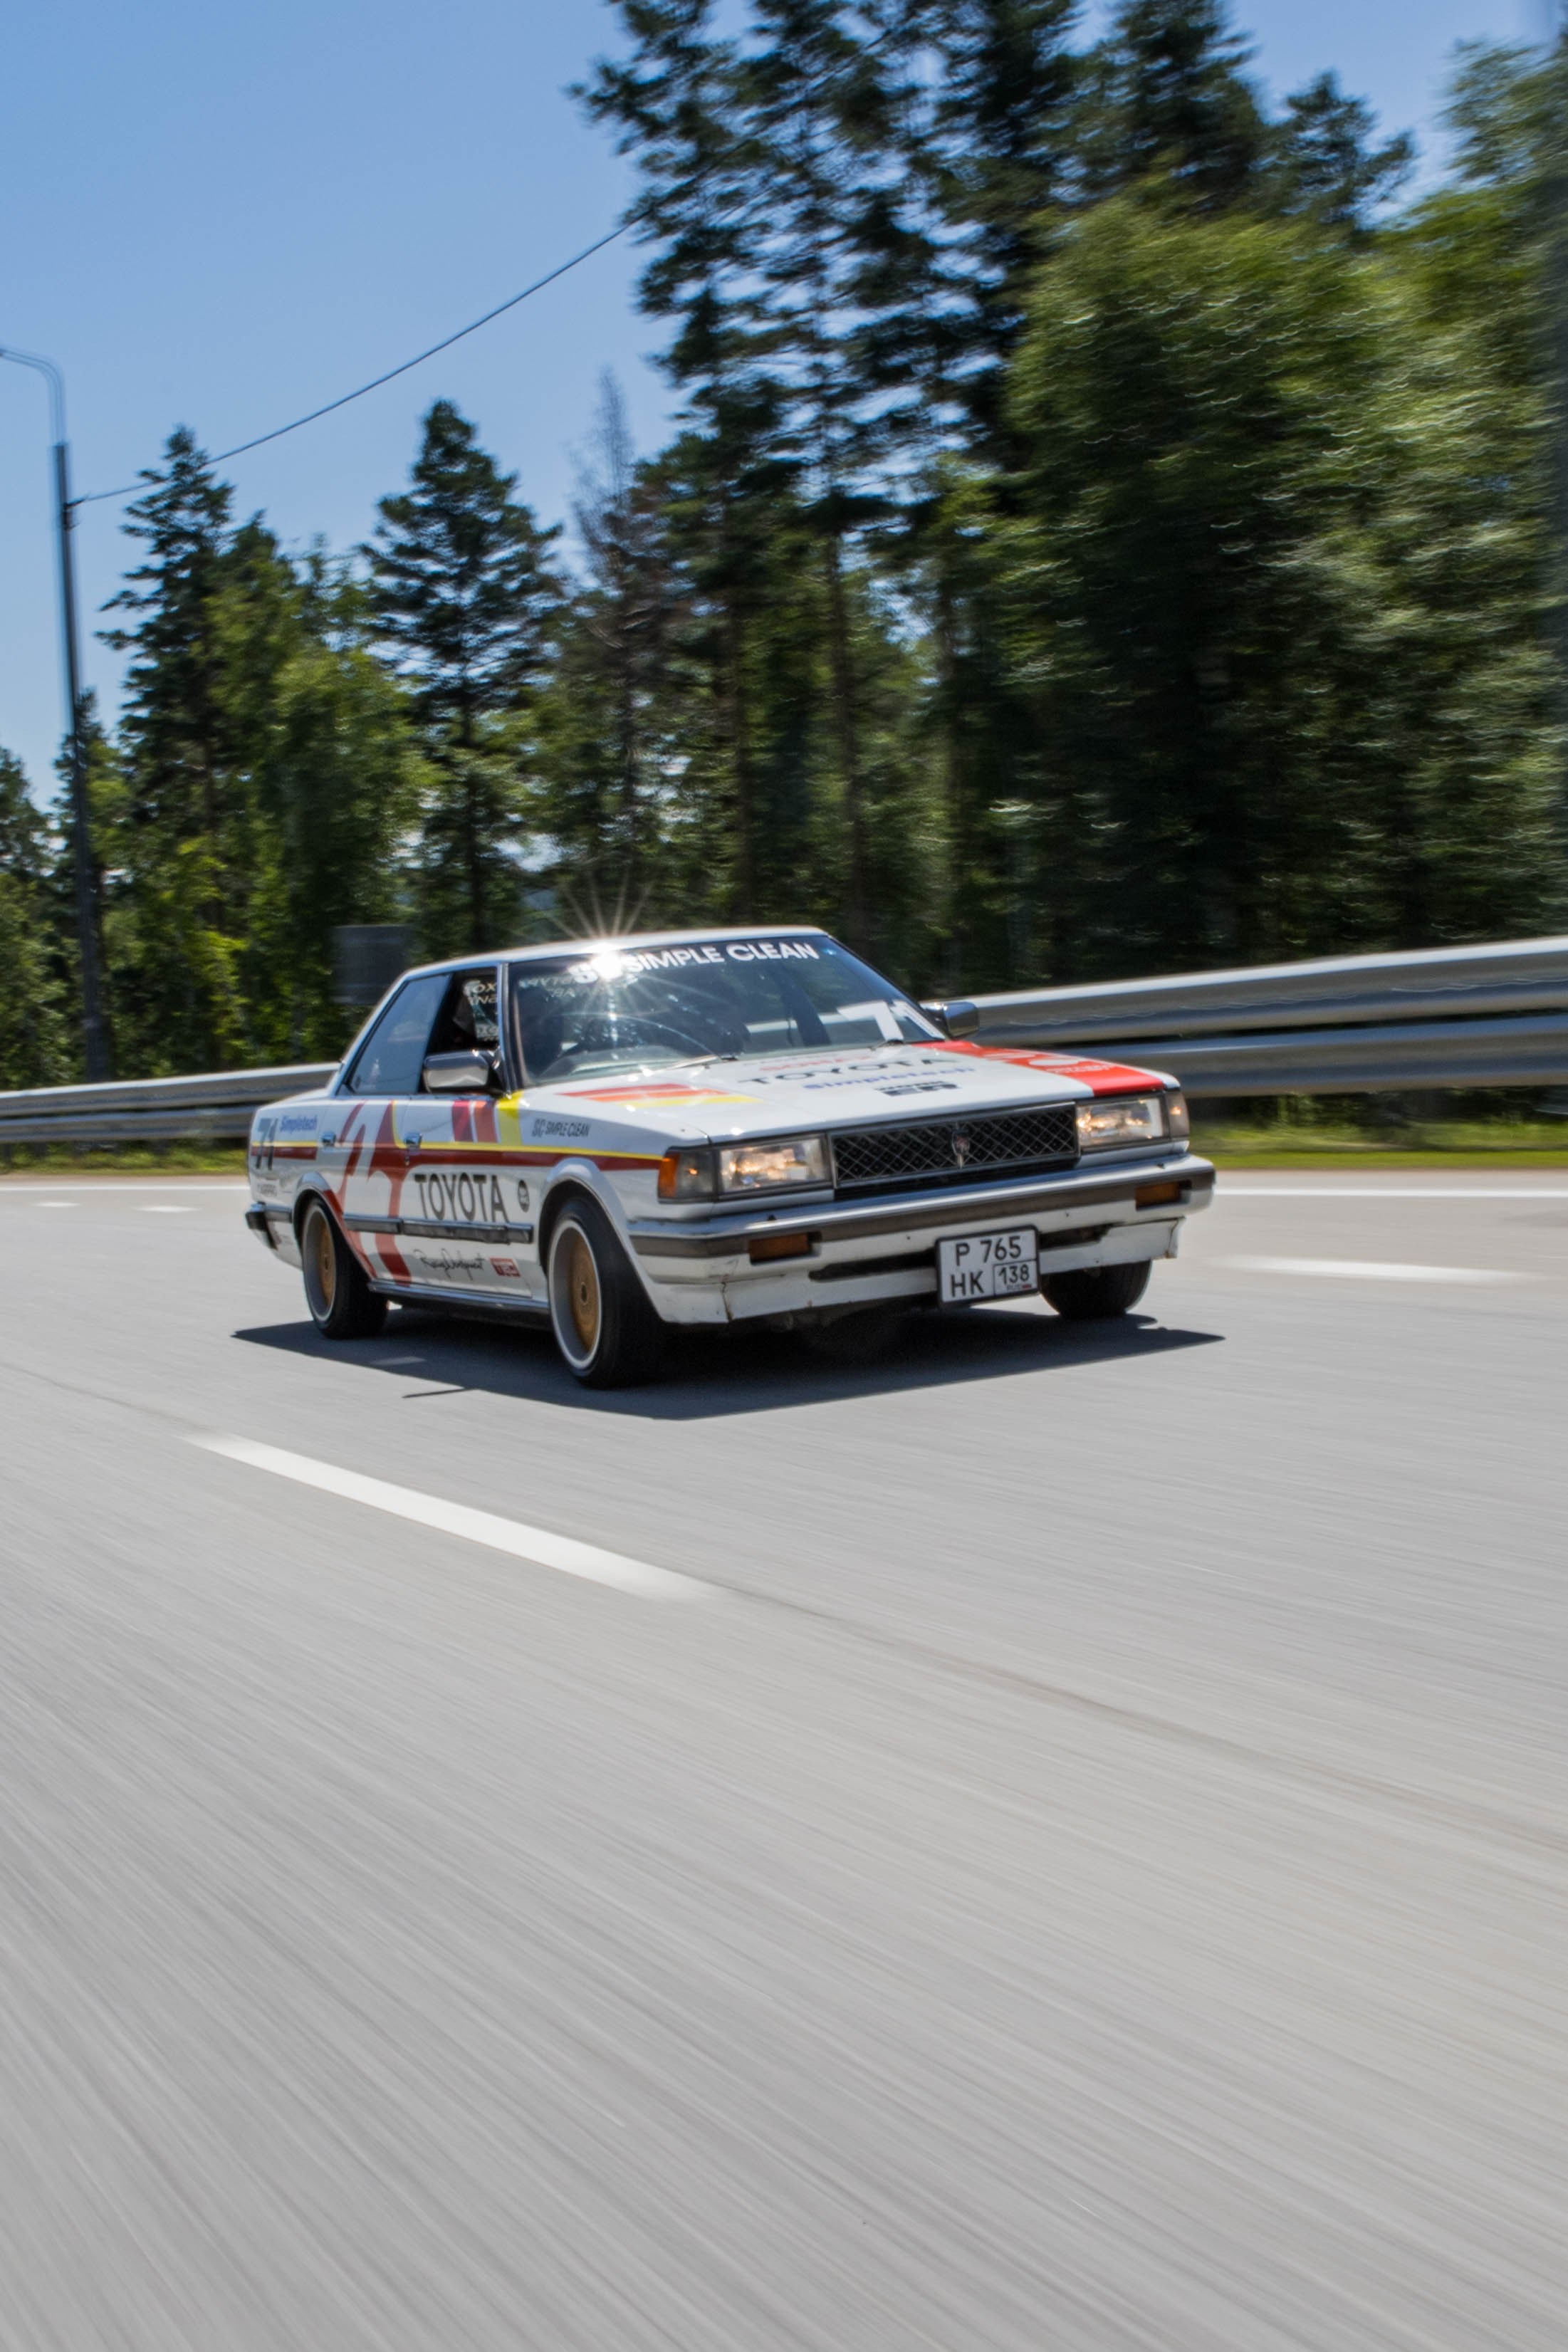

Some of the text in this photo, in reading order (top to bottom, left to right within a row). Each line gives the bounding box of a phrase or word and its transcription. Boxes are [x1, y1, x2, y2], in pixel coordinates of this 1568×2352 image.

[622, 944, 725, 973] SIMPLE
[726, 942, 820, 962] CLEAN
[837, 998, 946, 1041] 71
[738, 1057, 961, 1084] TOYOTA
[256, 1117, 278, 1171] 71
[414, 1172, 510, 1223] TOYOTA
[955, 1235, 1021, 1266] P 765
[951, 1264, 1030, 1297] HK 138
